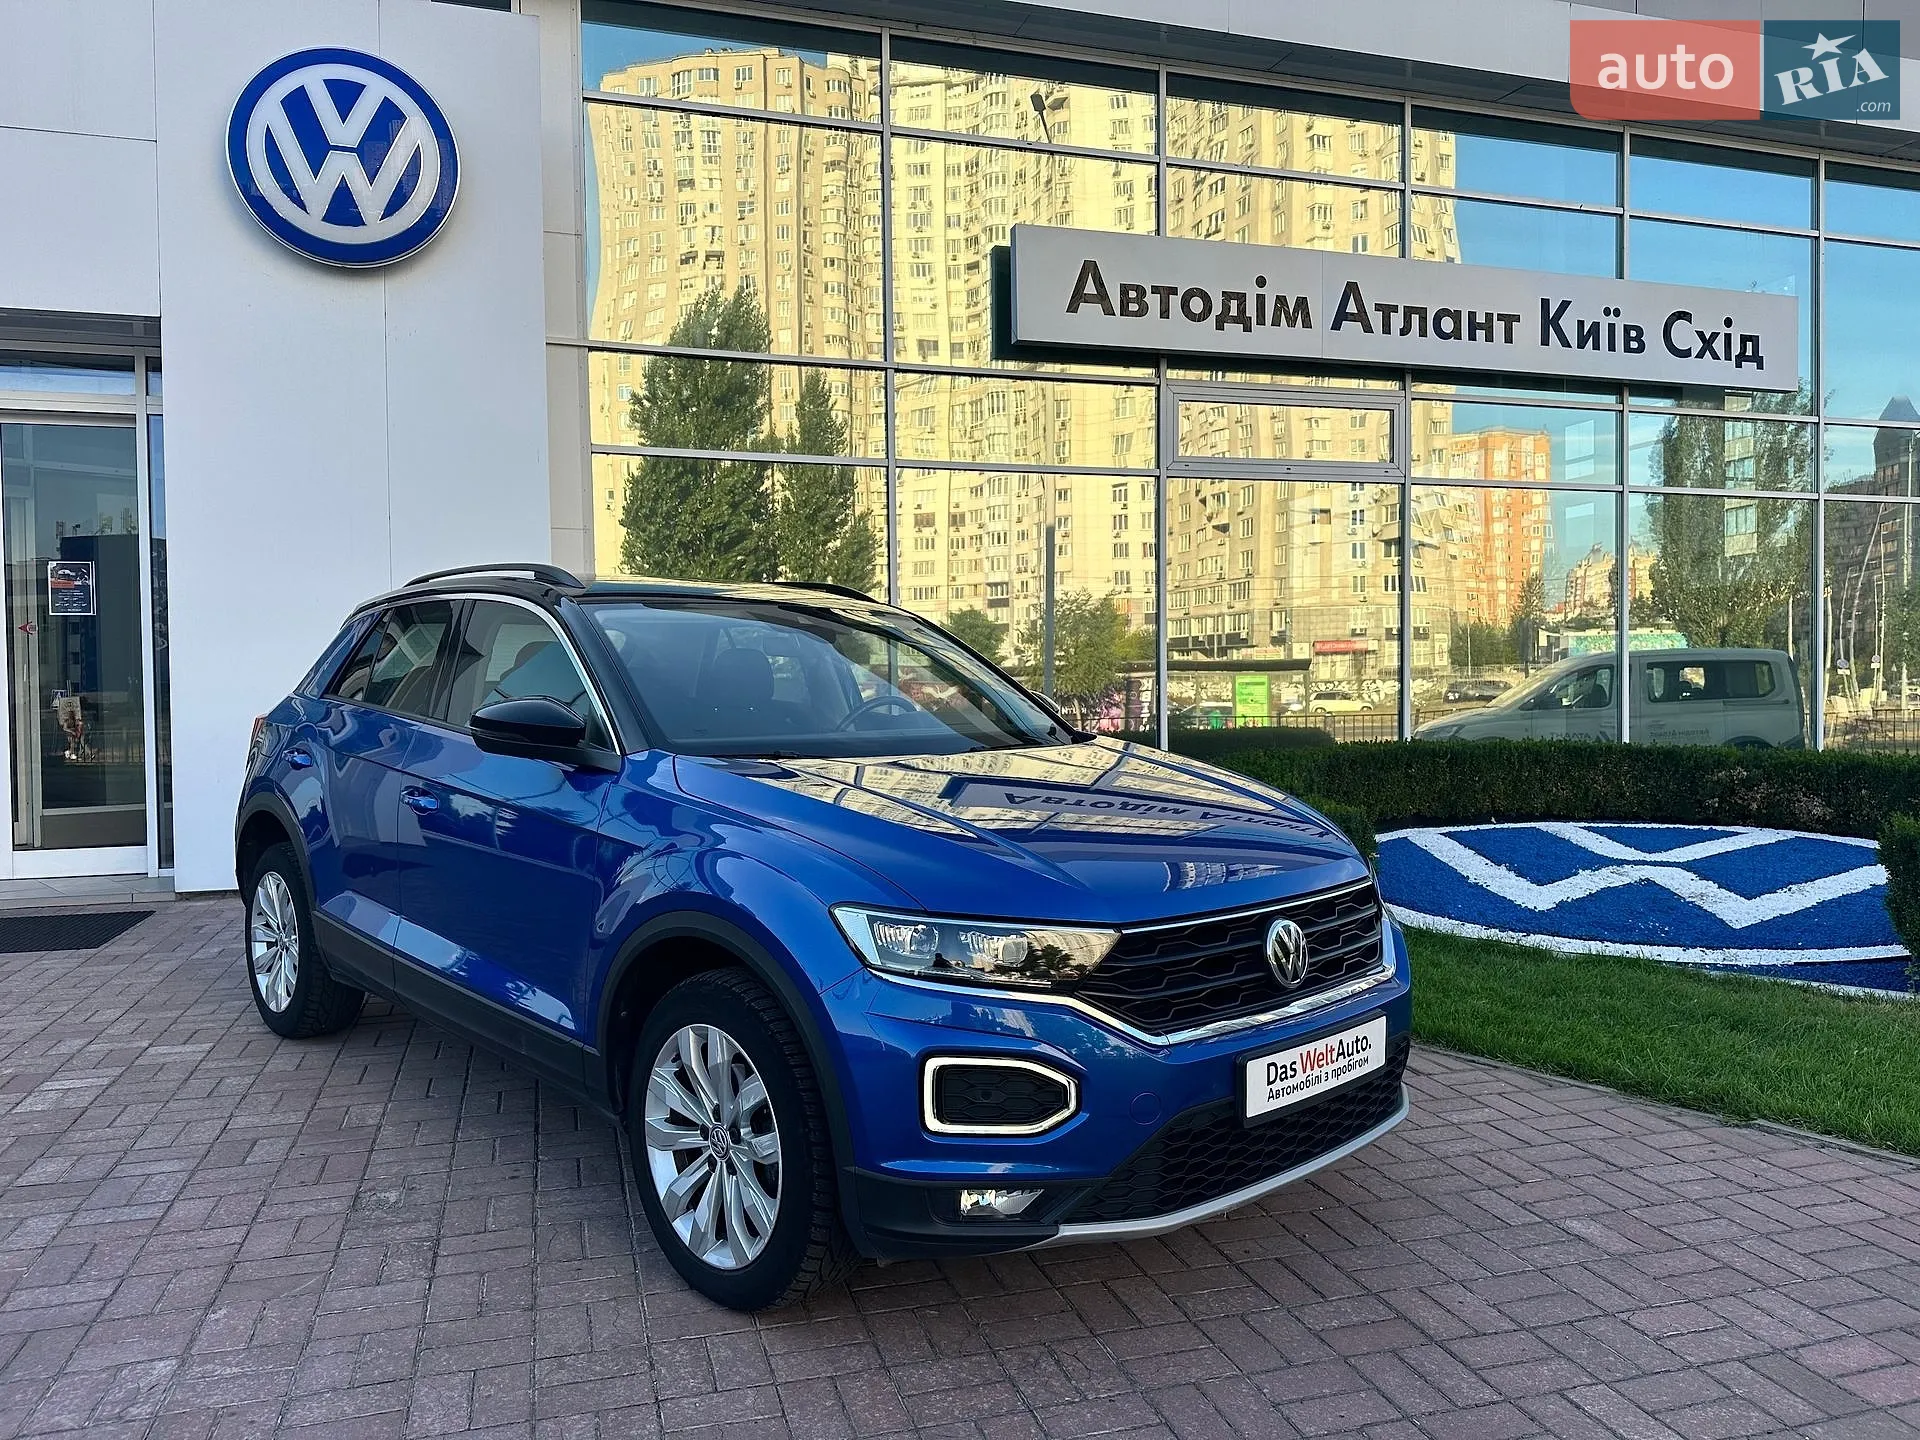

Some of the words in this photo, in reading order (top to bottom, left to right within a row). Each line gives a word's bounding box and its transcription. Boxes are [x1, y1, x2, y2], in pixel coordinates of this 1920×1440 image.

[1066, 259, 1313, 334] Автодім
[1330, 281, 1521, 347] Атлант
[1539, 298, 1646, 356] Київ
[1662, 310, 1765, 371] Схід
[1266, 1060, 1297, 1087] Das
[1267, 1071, 1322, 1103] Автомобілі
[1324, 1071, 1329, 1082] з
[1331, 1055, 1369, 1081] пробігом
